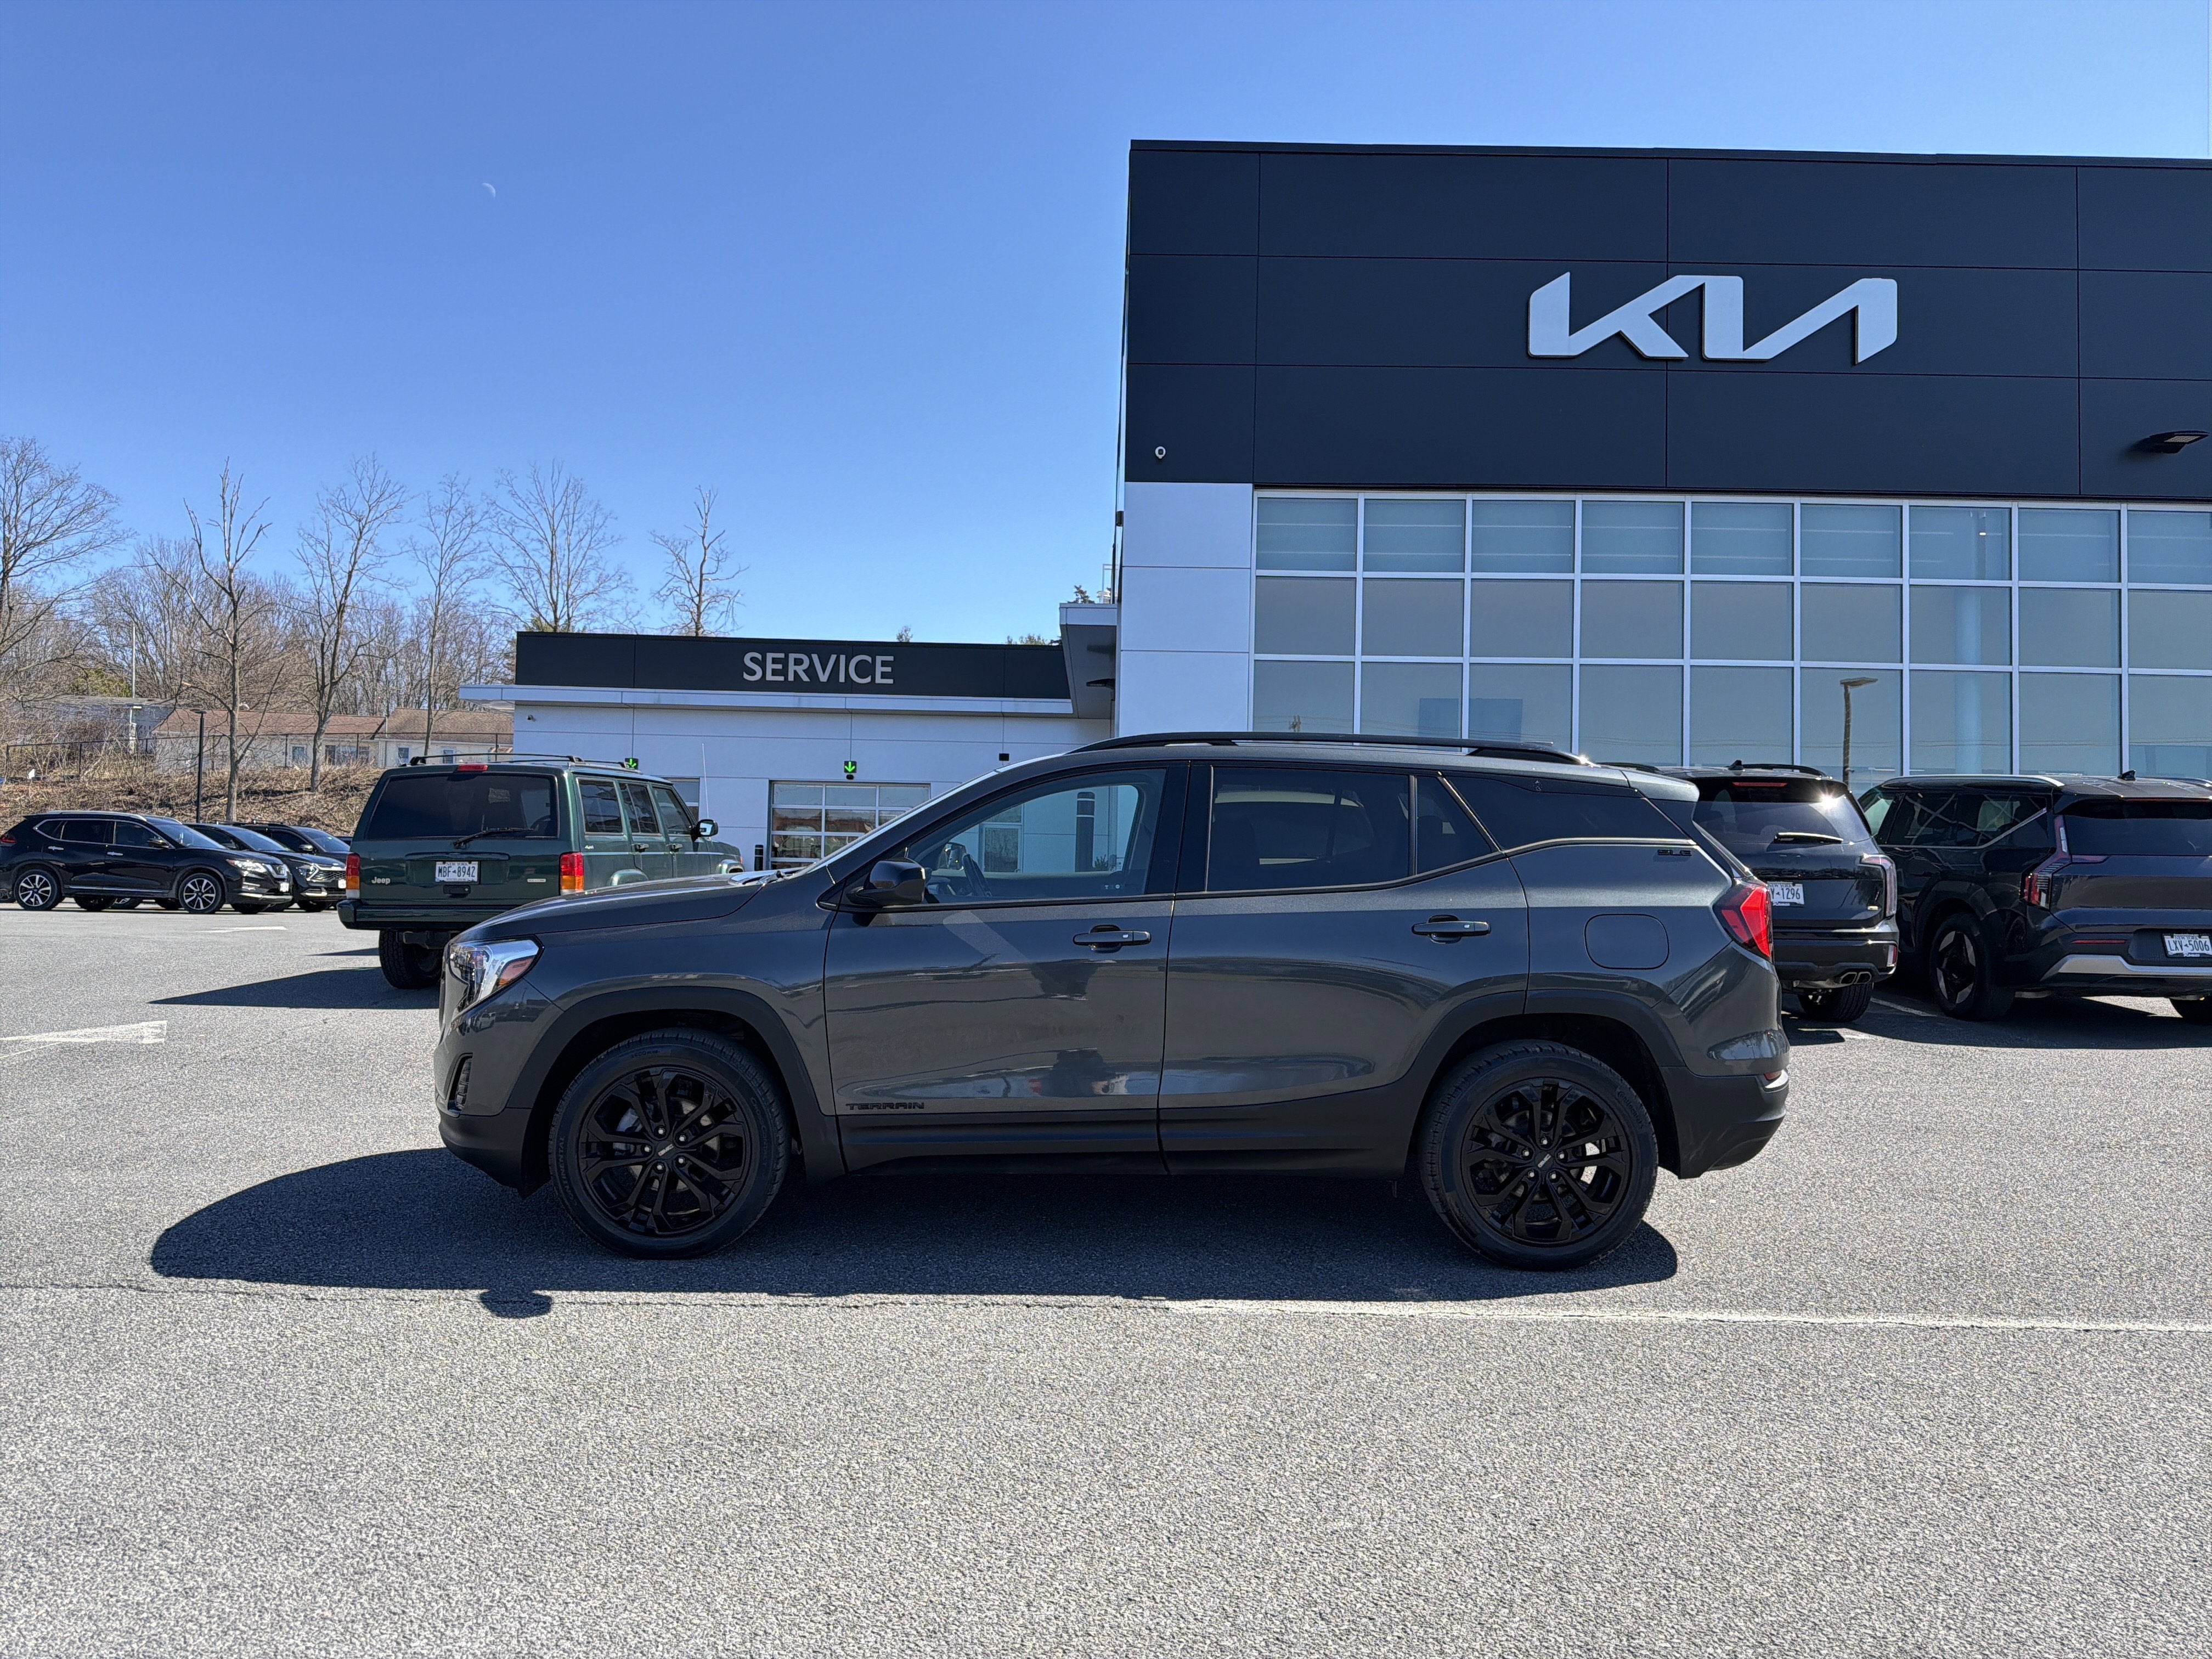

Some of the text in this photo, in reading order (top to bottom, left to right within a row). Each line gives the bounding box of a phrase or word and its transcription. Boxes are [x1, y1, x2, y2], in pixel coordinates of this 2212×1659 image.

[1528, 272, 1898, 365] KIA
[743, 652, 894, 684] SERVICE
[457, 866, 476, 877] 8942
[371, 877, 391, 885] Jeep
[1781, 888, 1801, 900] 1296
[2188, 940, 2210, 951] 5006
[845, 1102, 924, 1110] TERRAIN
[558, 1136, 577, 1206] CONTINENTAL
